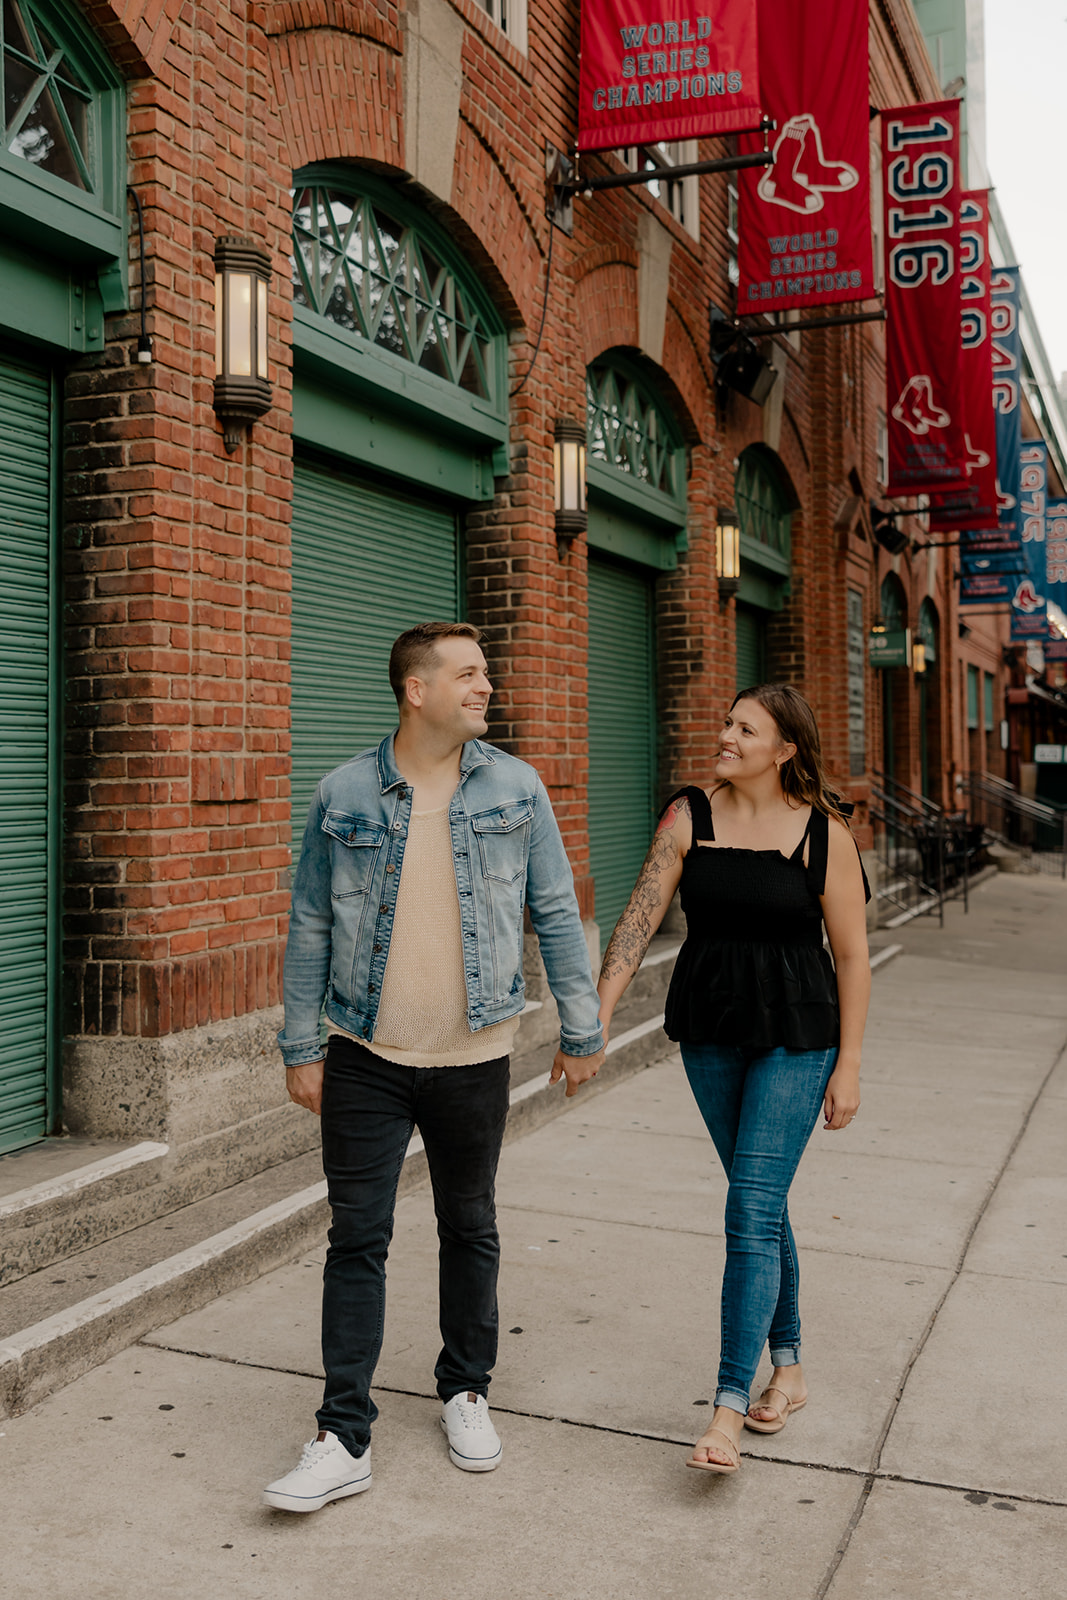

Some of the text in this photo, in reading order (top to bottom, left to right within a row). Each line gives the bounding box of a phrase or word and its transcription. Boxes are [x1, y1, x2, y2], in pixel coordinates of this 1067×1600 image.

[620, 16, 712, 50] WORLD
[621, 45, 710, 78] SERIES
[592, 70, 743, 111] CHAMPIONS
[887, 116, 954, 289] 1916
[768, 228, 838, 254] WORLD
[770, 251, 837, 276] SERIES
[747, 269, 861, 301] CHAMPIONS
